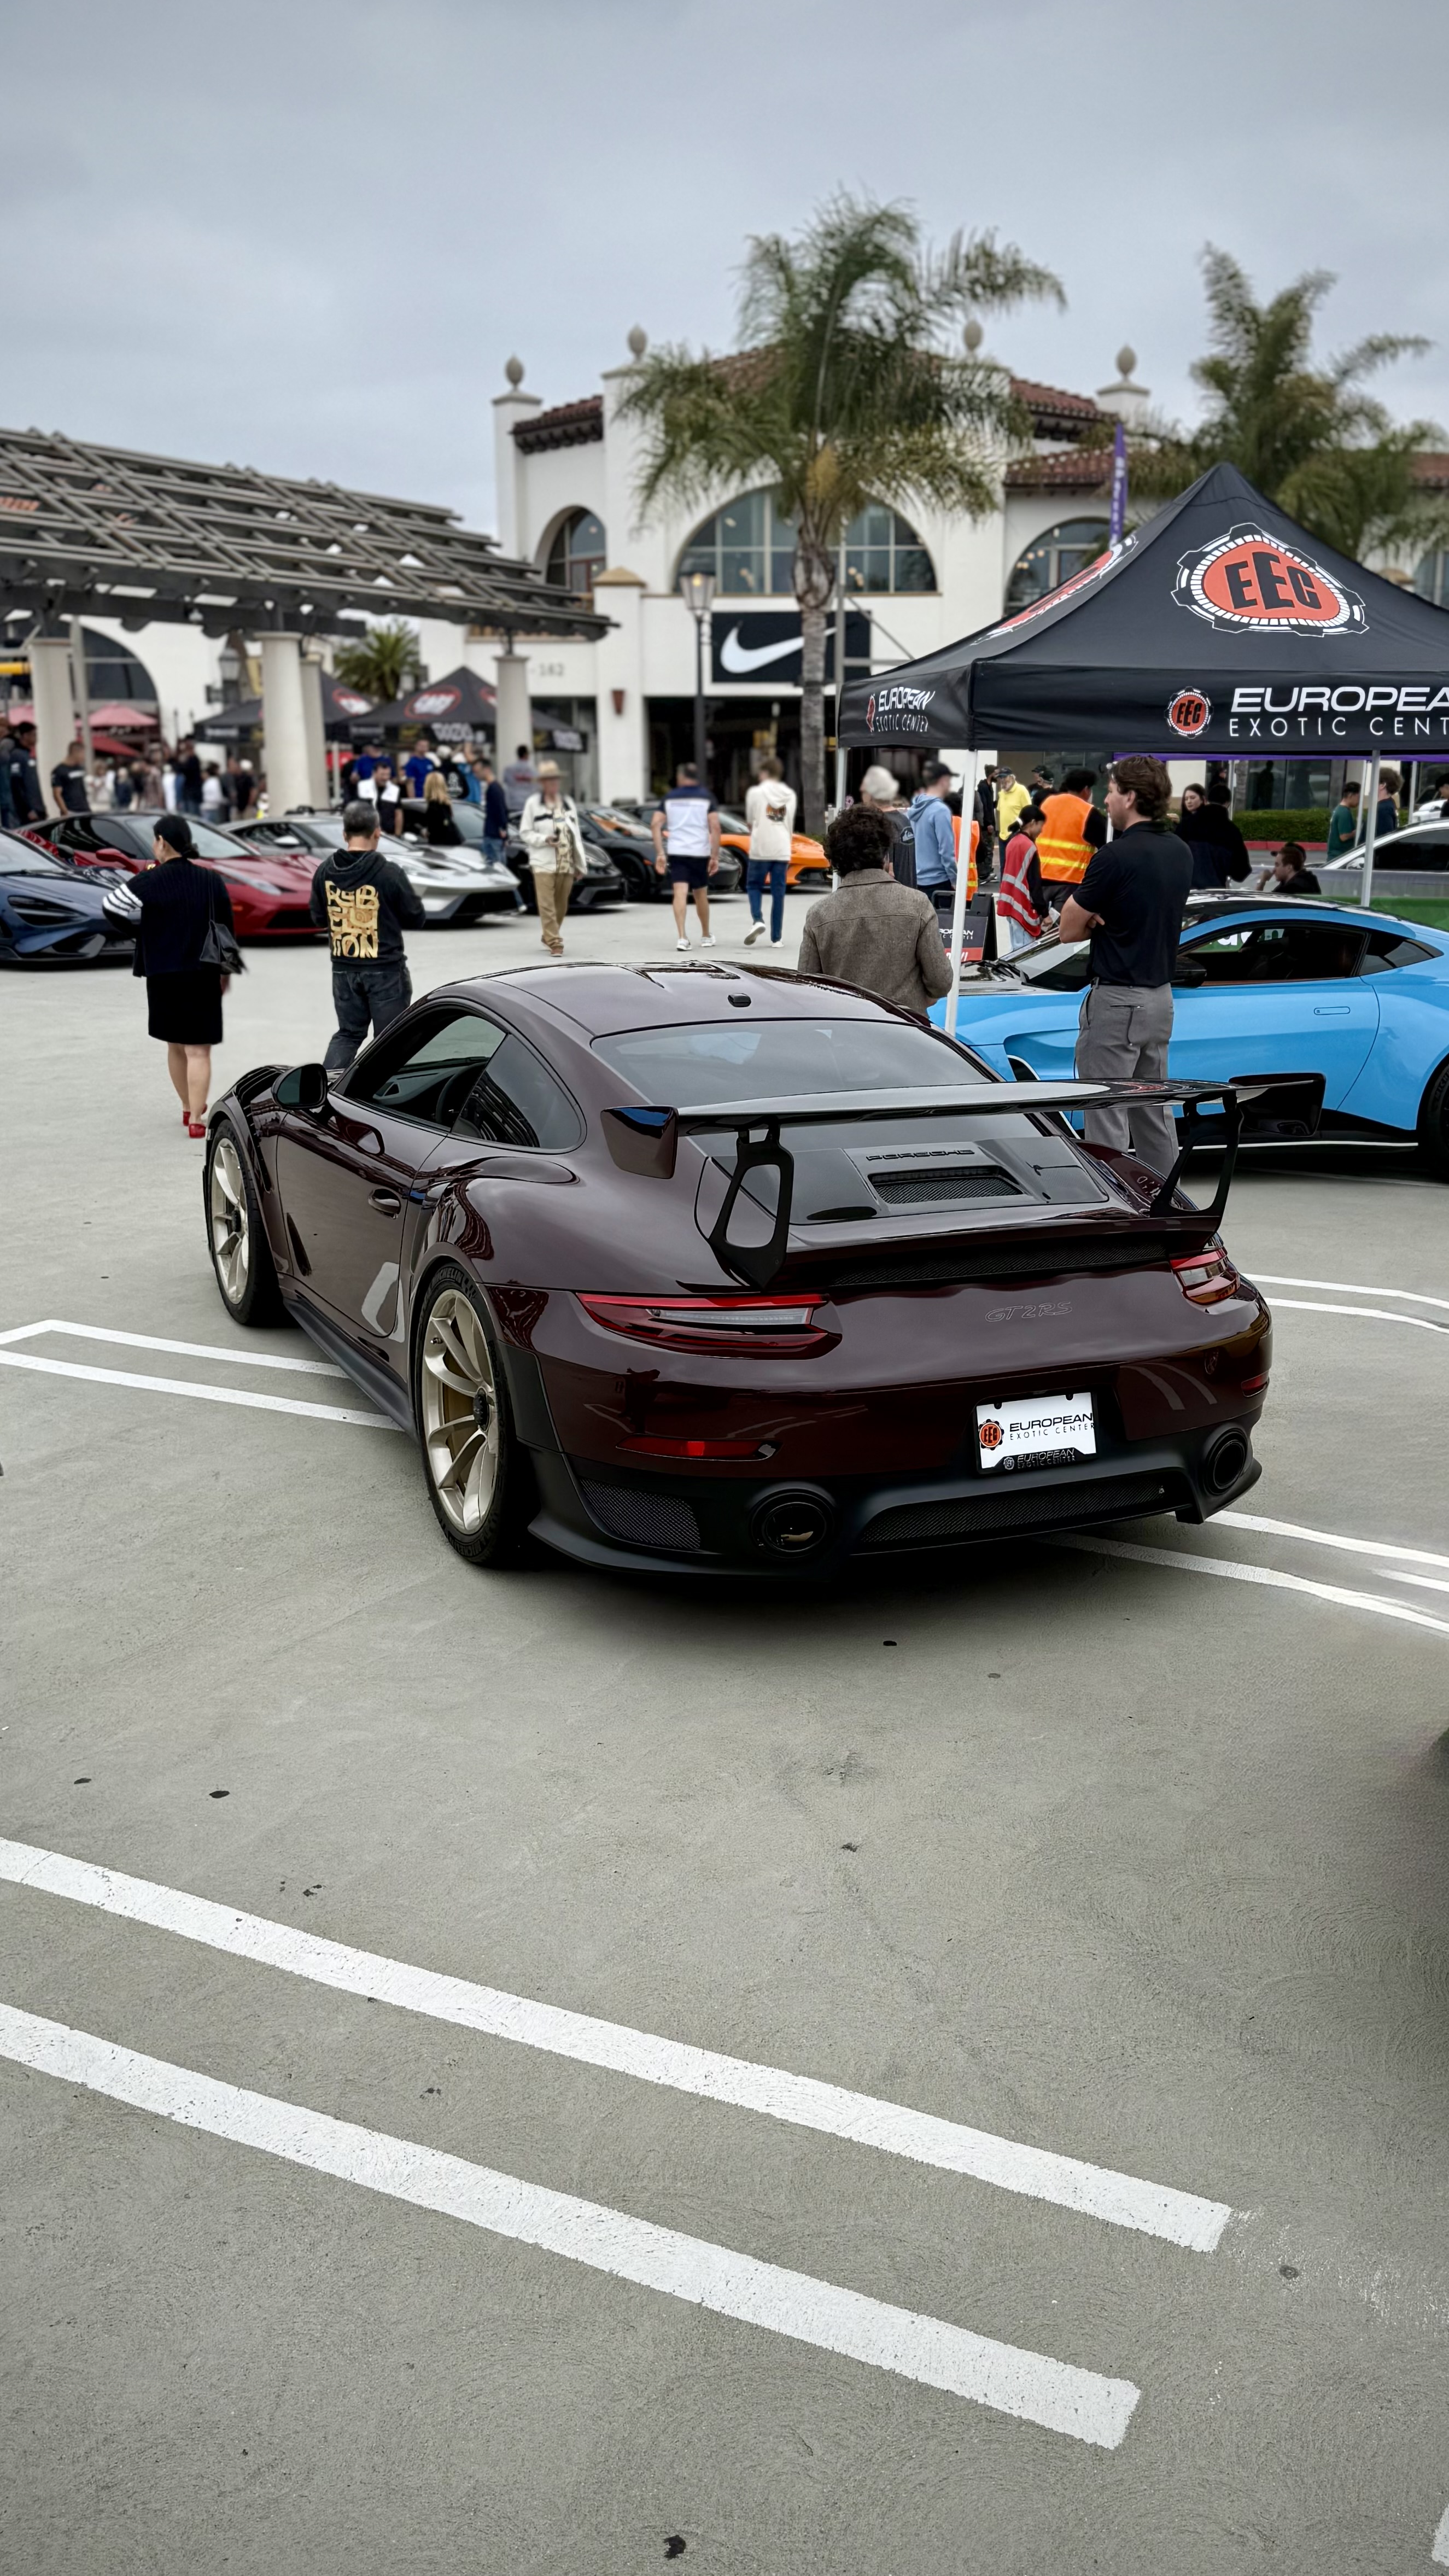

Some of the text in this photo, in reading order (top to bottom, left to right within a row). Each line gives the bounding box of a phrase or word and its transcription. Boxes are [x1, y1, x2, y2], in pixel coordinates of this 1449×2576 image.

[1225, 551, 1322, 610] EEC
[879, 687, 936, 711] EUROPEAN
[1176, 699, 1203, 727] EEC
[876, 714, 928, 732] EXOTIC CENTER
[1230, 717, 1346, 736] EXOTIC
[866, 1150, 975, 1161] PORSCHE
[1009, 1413, 1092, 1432] EUROPEAN
[1010, 1422, 1094, 1440] EXOTIC CENTER
[1018, 1448, 1074, 1463] EUROPEAN
